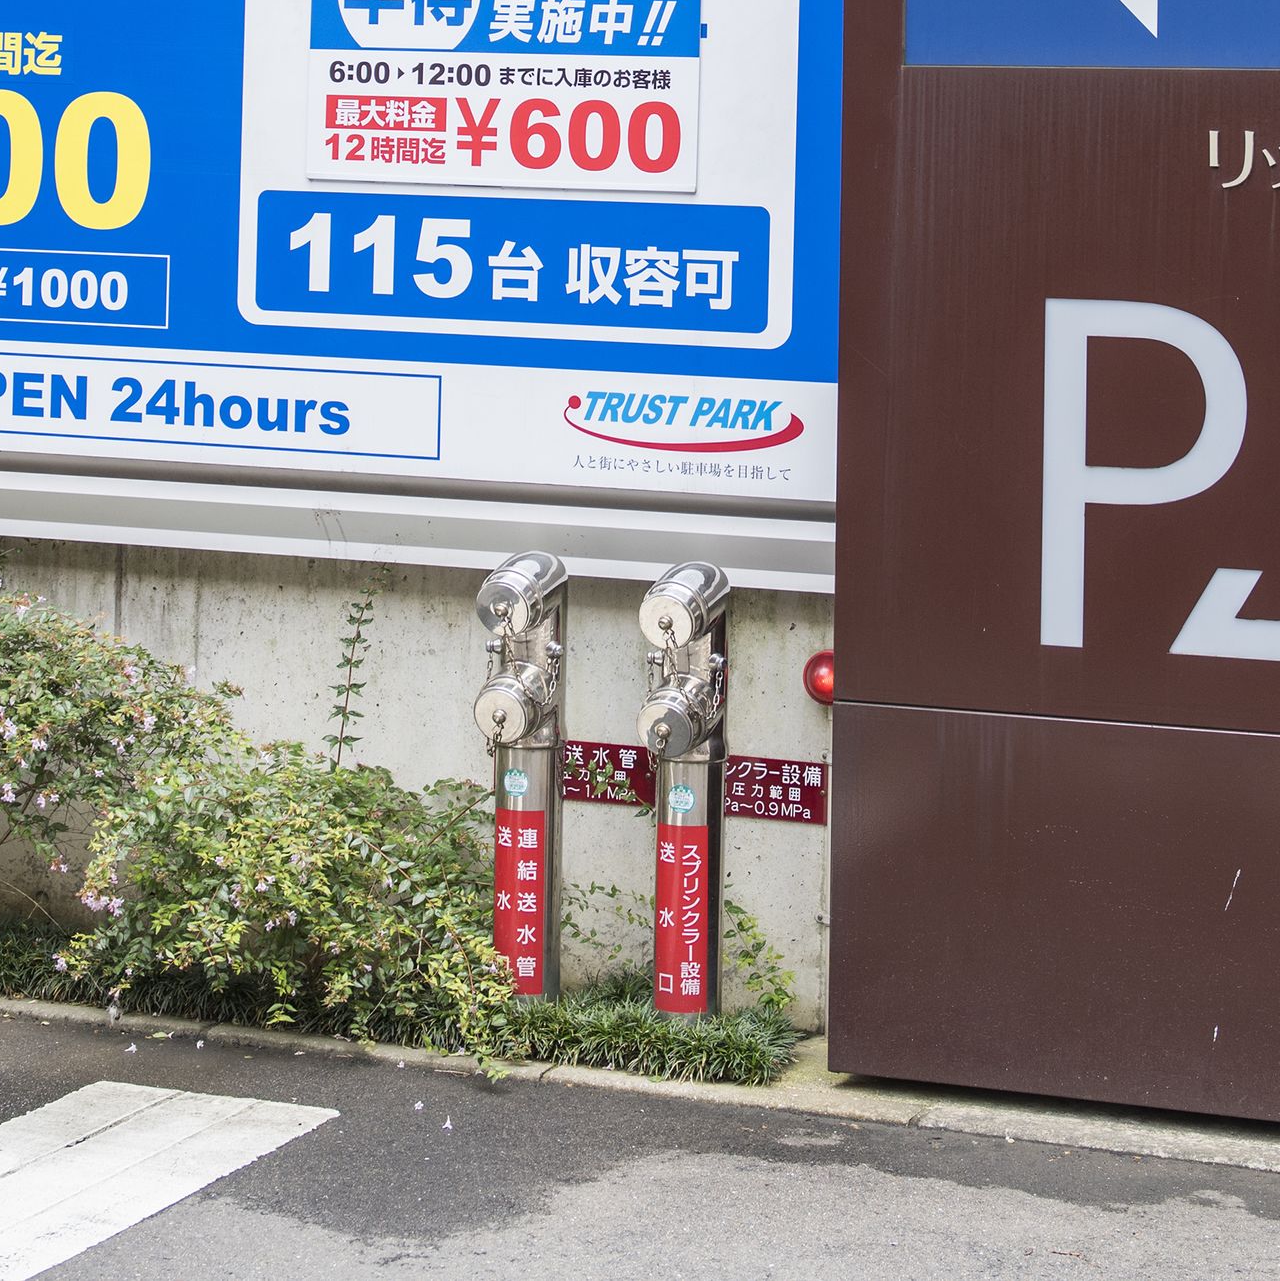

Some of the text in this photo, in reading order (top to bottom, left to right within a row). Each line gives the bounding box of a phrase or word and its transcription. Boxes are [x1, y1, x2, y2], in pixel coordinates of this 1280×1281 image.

[499, 66, 671, 91] までに入庫のお客様
[335, 99, 436, 129] 最大料金
[325, 134, 446, 165] 12時間迄
[456, 97, 682, 174] ¥600
[565, 244, 739, 310] 収容可
[110, 378, 351, 436] 24hours
[584, 391, 783, 431] TRUST PARK
[573, 454, 791, 482] 人と街にやさしい駐車場を目指して
[725, 782, 801, 801] 圧力範囲
[517, 828, 537, 977] 連結送水管
[659, 841, 701, 996] 送水口 スプリンクラー設備
